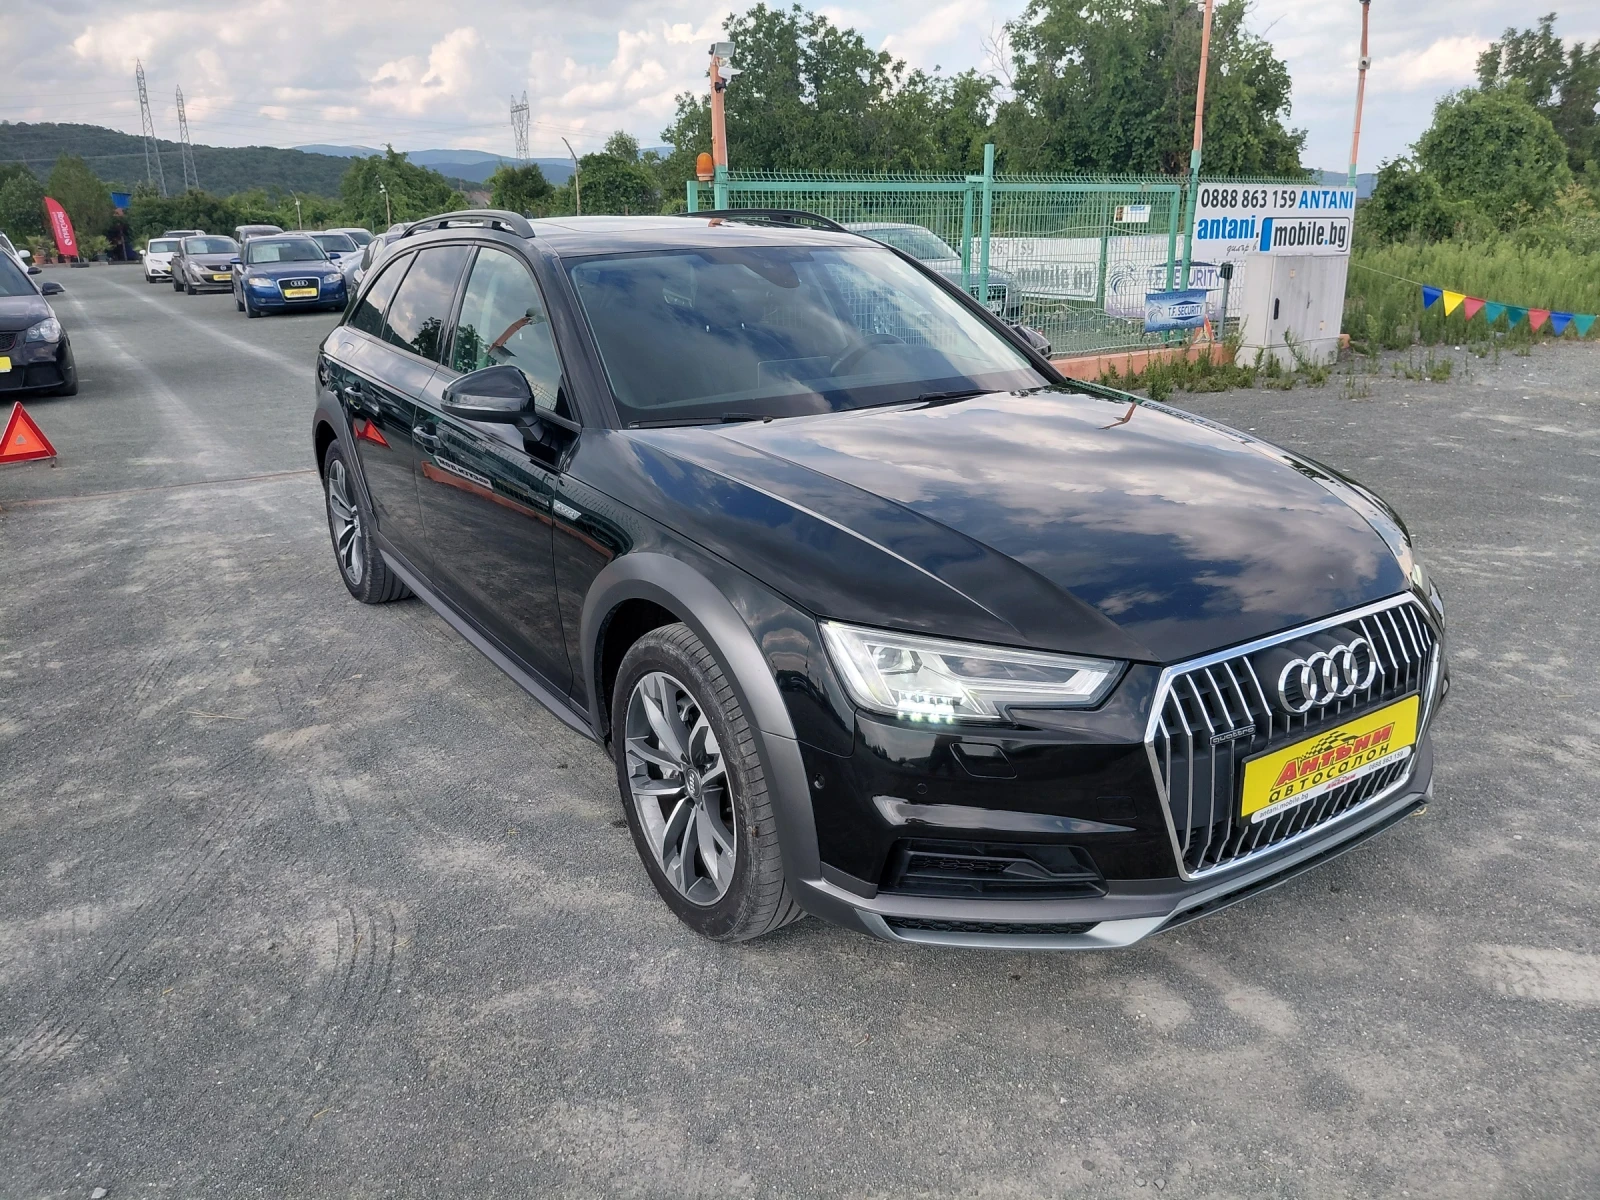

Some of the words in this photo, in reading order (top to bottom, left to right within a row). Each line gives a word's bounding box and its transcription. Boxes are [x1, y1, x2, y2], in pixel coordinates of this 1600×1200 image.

[1201, 189, 1238, 208] 0888
[1241, 189, 1267, 208] 863
[1273, 190, 1296, 208] 159
[1298, 190, 1354, 209] ANTANI
[1273, 221, 1347, 248] mobile.bg
[1177, 305, 1203, 316] SECURITY
[1212, 726, 1255, 743] quattro
[1259, 792, 1309, 819] antani.mobile.bg
